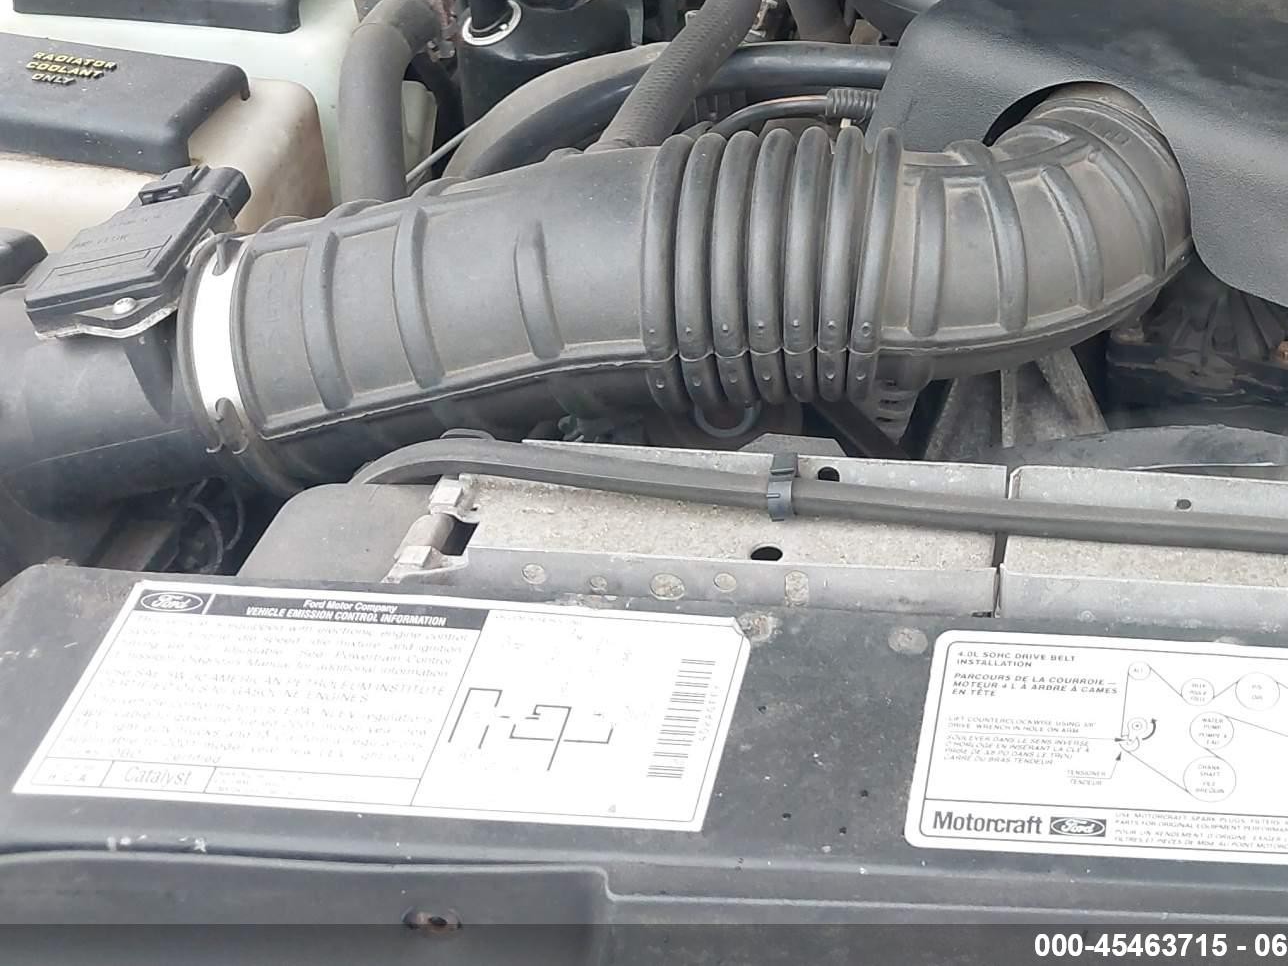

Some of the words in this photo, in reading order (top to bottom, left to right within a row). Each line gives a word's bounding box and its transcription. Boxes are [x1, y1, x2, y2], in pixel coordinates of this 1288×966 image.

[32, 51, 117, 71] RADIATOR
[26, 61, 104, 79] COOLANT
[31, 73, 77, 86] ONLY
[146, 593, 197, 611] Ford
[302, 598, 326, 608] Ford
[325, 599, 353, 610] Motor
[354, 601, 397, 613] Company
[245, 606, 286, 617] VEHICLE
[285, 609, 334, 621] EMISSION
[334, 611, 378, 624] CONTROL
[379, 614, 446, 628] INFORMATION
[956, 659, 1032, 668] INSTALLATION
[1014, 653, 1046, 661] DRIVE
[1047, 654, 1075, 662] BELT
[952, 681, 1000, 689] MOTEUR
[1079, 686, 1118, 694] CAMES
[953, 673, 1011, 682] PARCOURS
[1048, 677, 1104, 686] COURROIE
[124, 766, 192, 787] Catalyst
[932, 811, 1043, 834] Motorcraft
[1056, 818, 1100, 835] Ford
